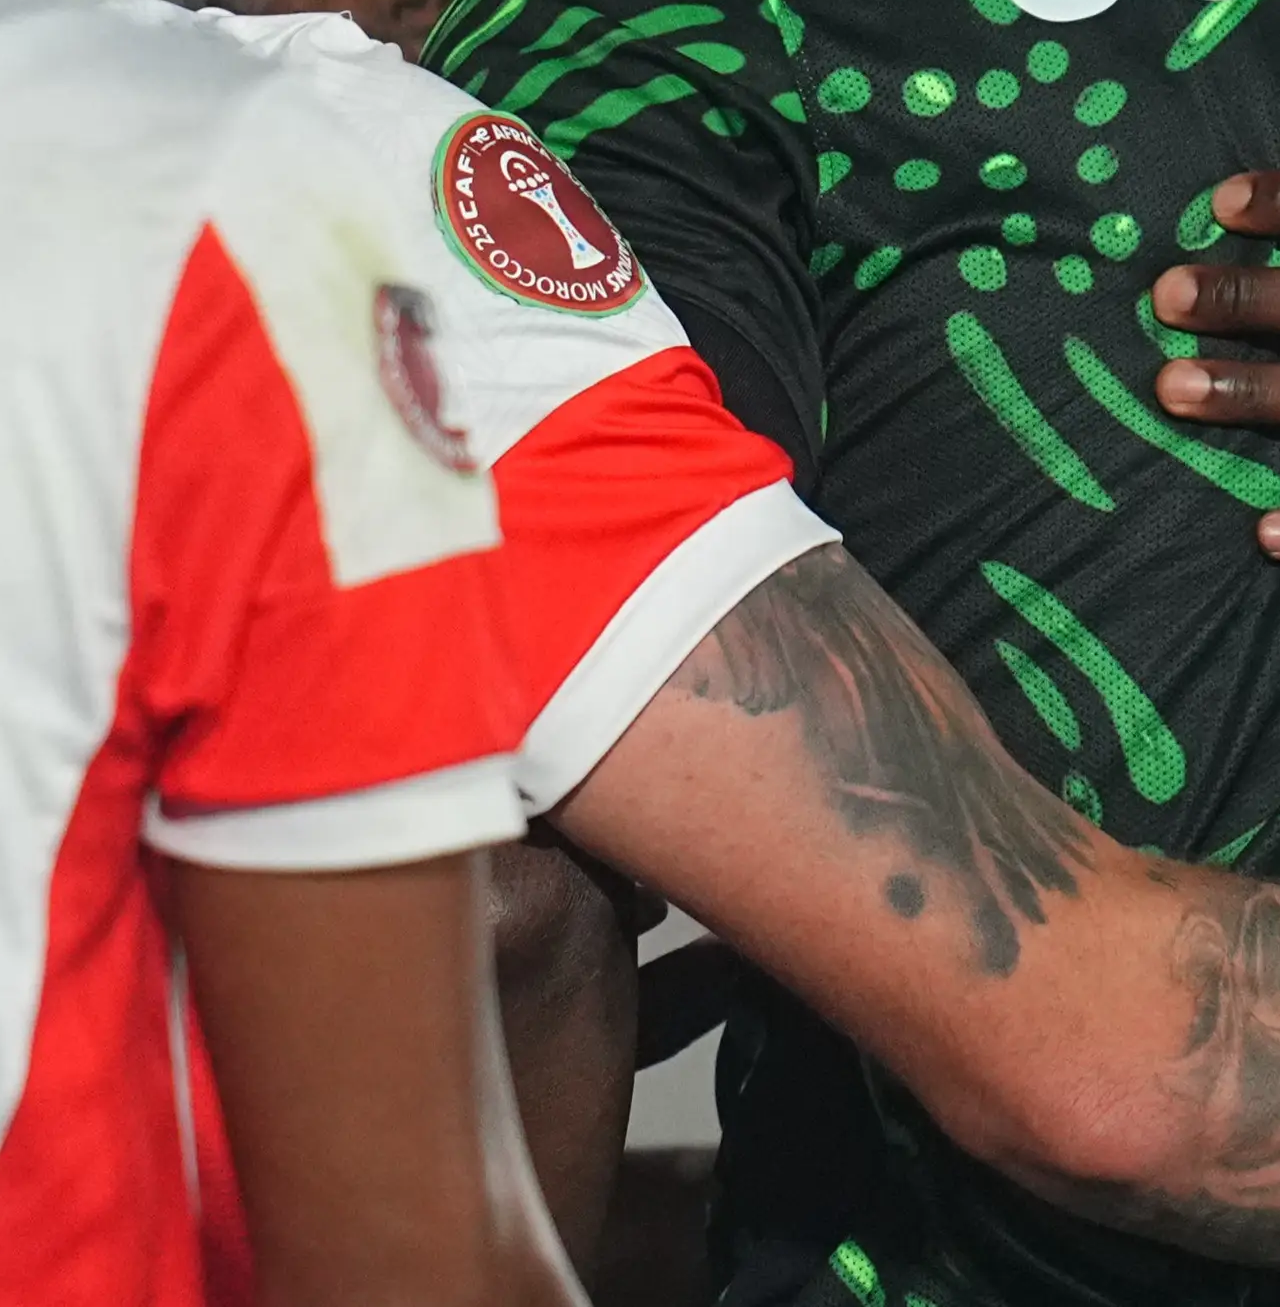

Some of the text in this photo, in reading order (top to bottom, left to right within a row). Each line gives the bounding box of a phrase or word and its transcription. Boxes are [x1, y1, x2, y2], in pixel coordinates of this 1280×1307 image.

[455, 152, 479, 220] CAF
[466, 223, 496, 251] 25
[489, 249, 608, 302] MOROCCO
